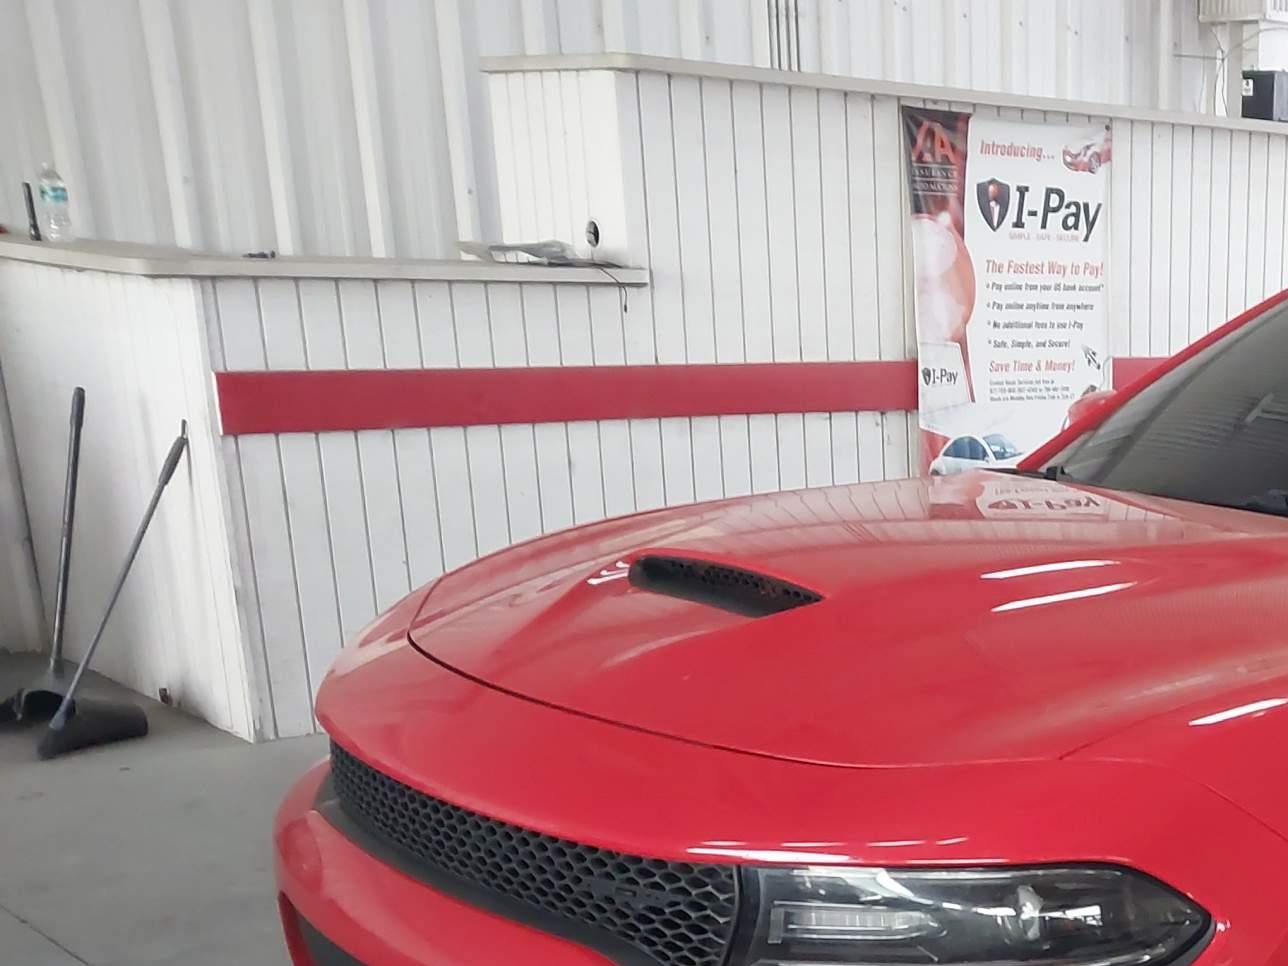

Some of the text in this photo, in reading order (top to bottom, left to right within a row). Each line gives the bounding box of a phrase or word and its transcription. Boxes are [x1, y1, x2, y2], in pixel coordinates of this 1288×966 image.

[980, 139, 1055, 162] Introducing...
[1012, 185, 1103, 243] I-Pay
[986, 259, 1104, 279] The Fastest Way to Pay!
[991, 282, 1002, 292] Pay
[1004, 283, 1022, 291] online
[1024, 283, 1038, 291] from
[1039, 284, 1052, 293] your
[1063, 283, 1076, 291] bank
[992, 301, 1094, 312] Pay online anytime from anywhere
[992, 320, 1001, 329] No
[1002, 320, 1034, 329] additional
[1035, 320, 1047, 329] fees
[1049, 320, 1055, 329] to
[993, 338, 1071, 349] Safe, Simple, and Secure!
[989, 360, 1076, 374] Save Time & Money!
[932, 368, 958, 385] I-Pay
